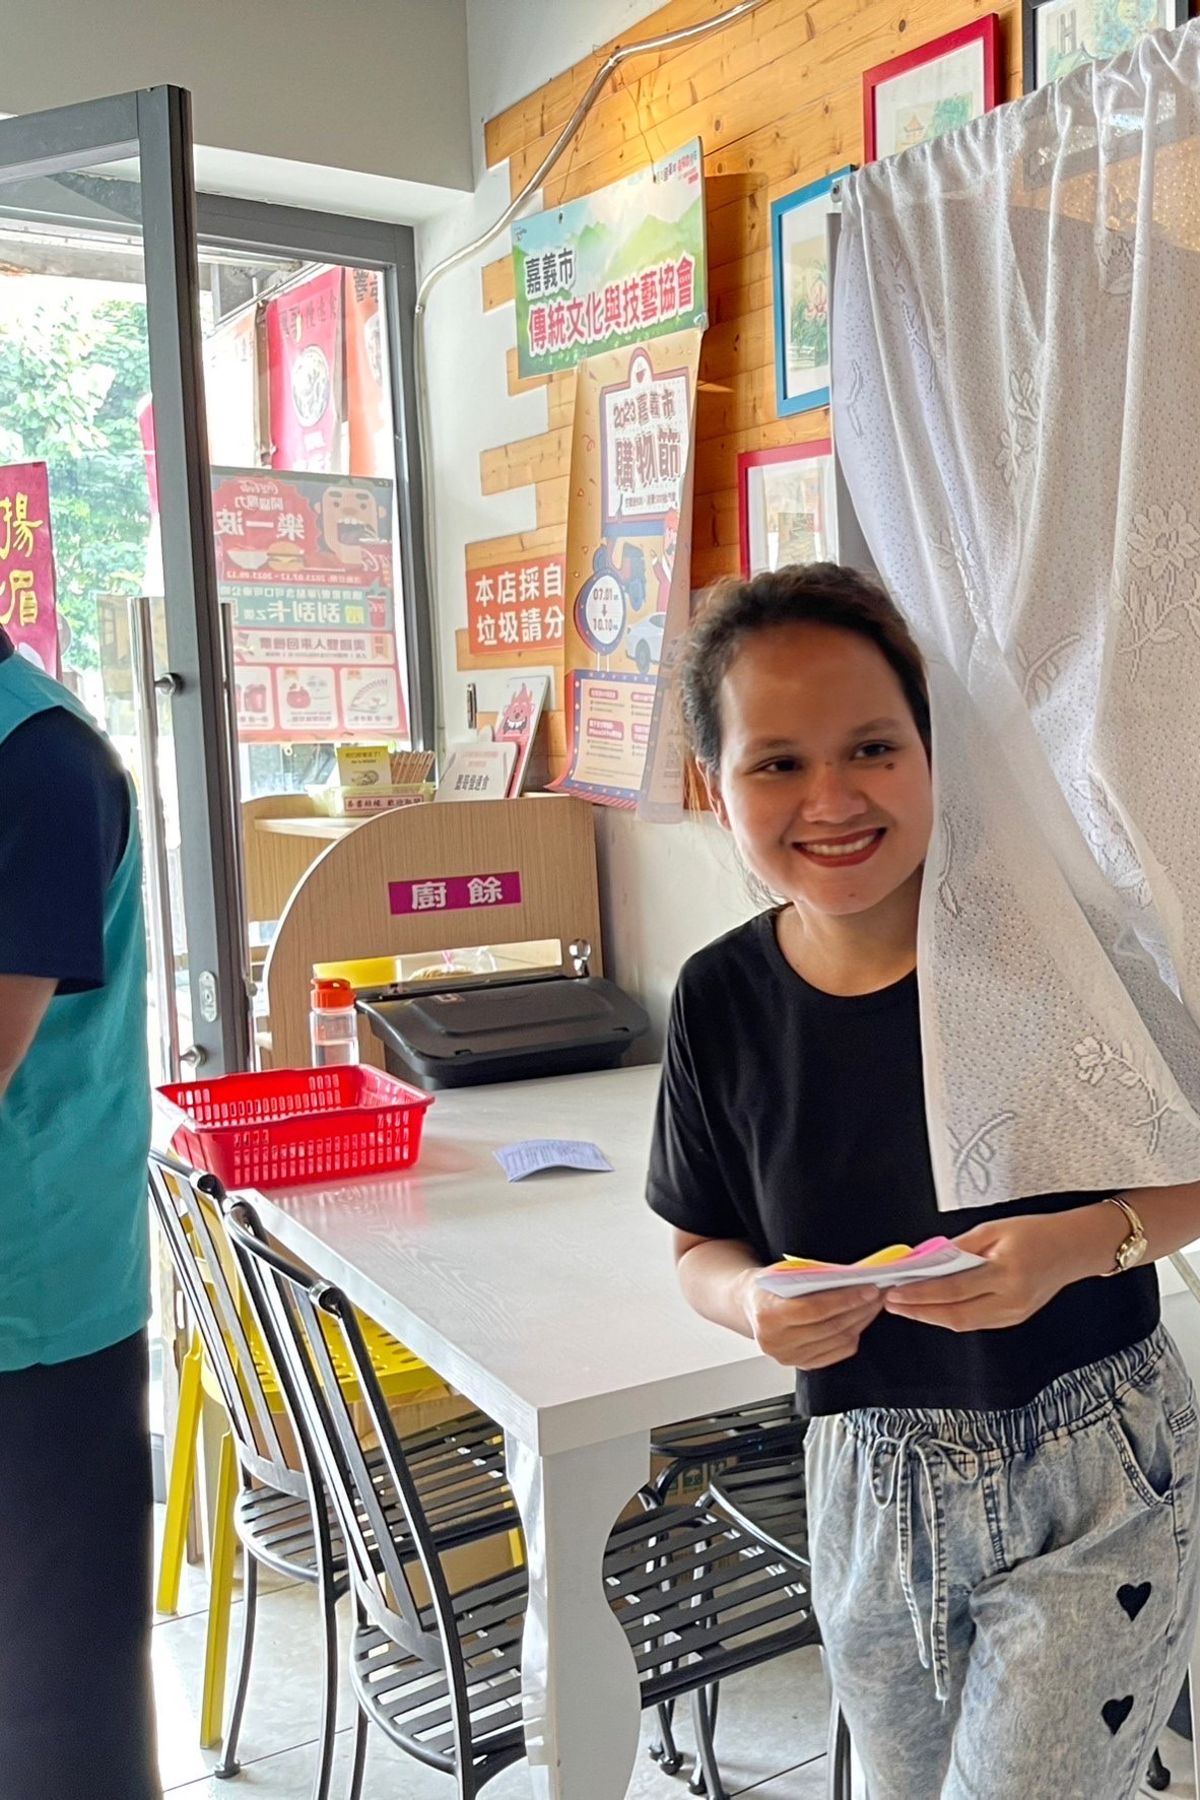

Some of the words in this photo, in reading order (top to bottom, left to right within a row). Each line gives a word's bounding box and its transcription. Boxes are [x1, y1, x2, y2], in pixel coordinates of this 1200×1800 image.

[525, 248, 574, 295] 嘉義市
[529, 256, 694, 351] 傳統文化與技藝協會
[615, 427, 682, 493] 購物節
[475, 563, 563, 607] 本店採自
[476, 606, 565, 646] 垃圾請分
[411, 876, 503, 910] 廚餘
